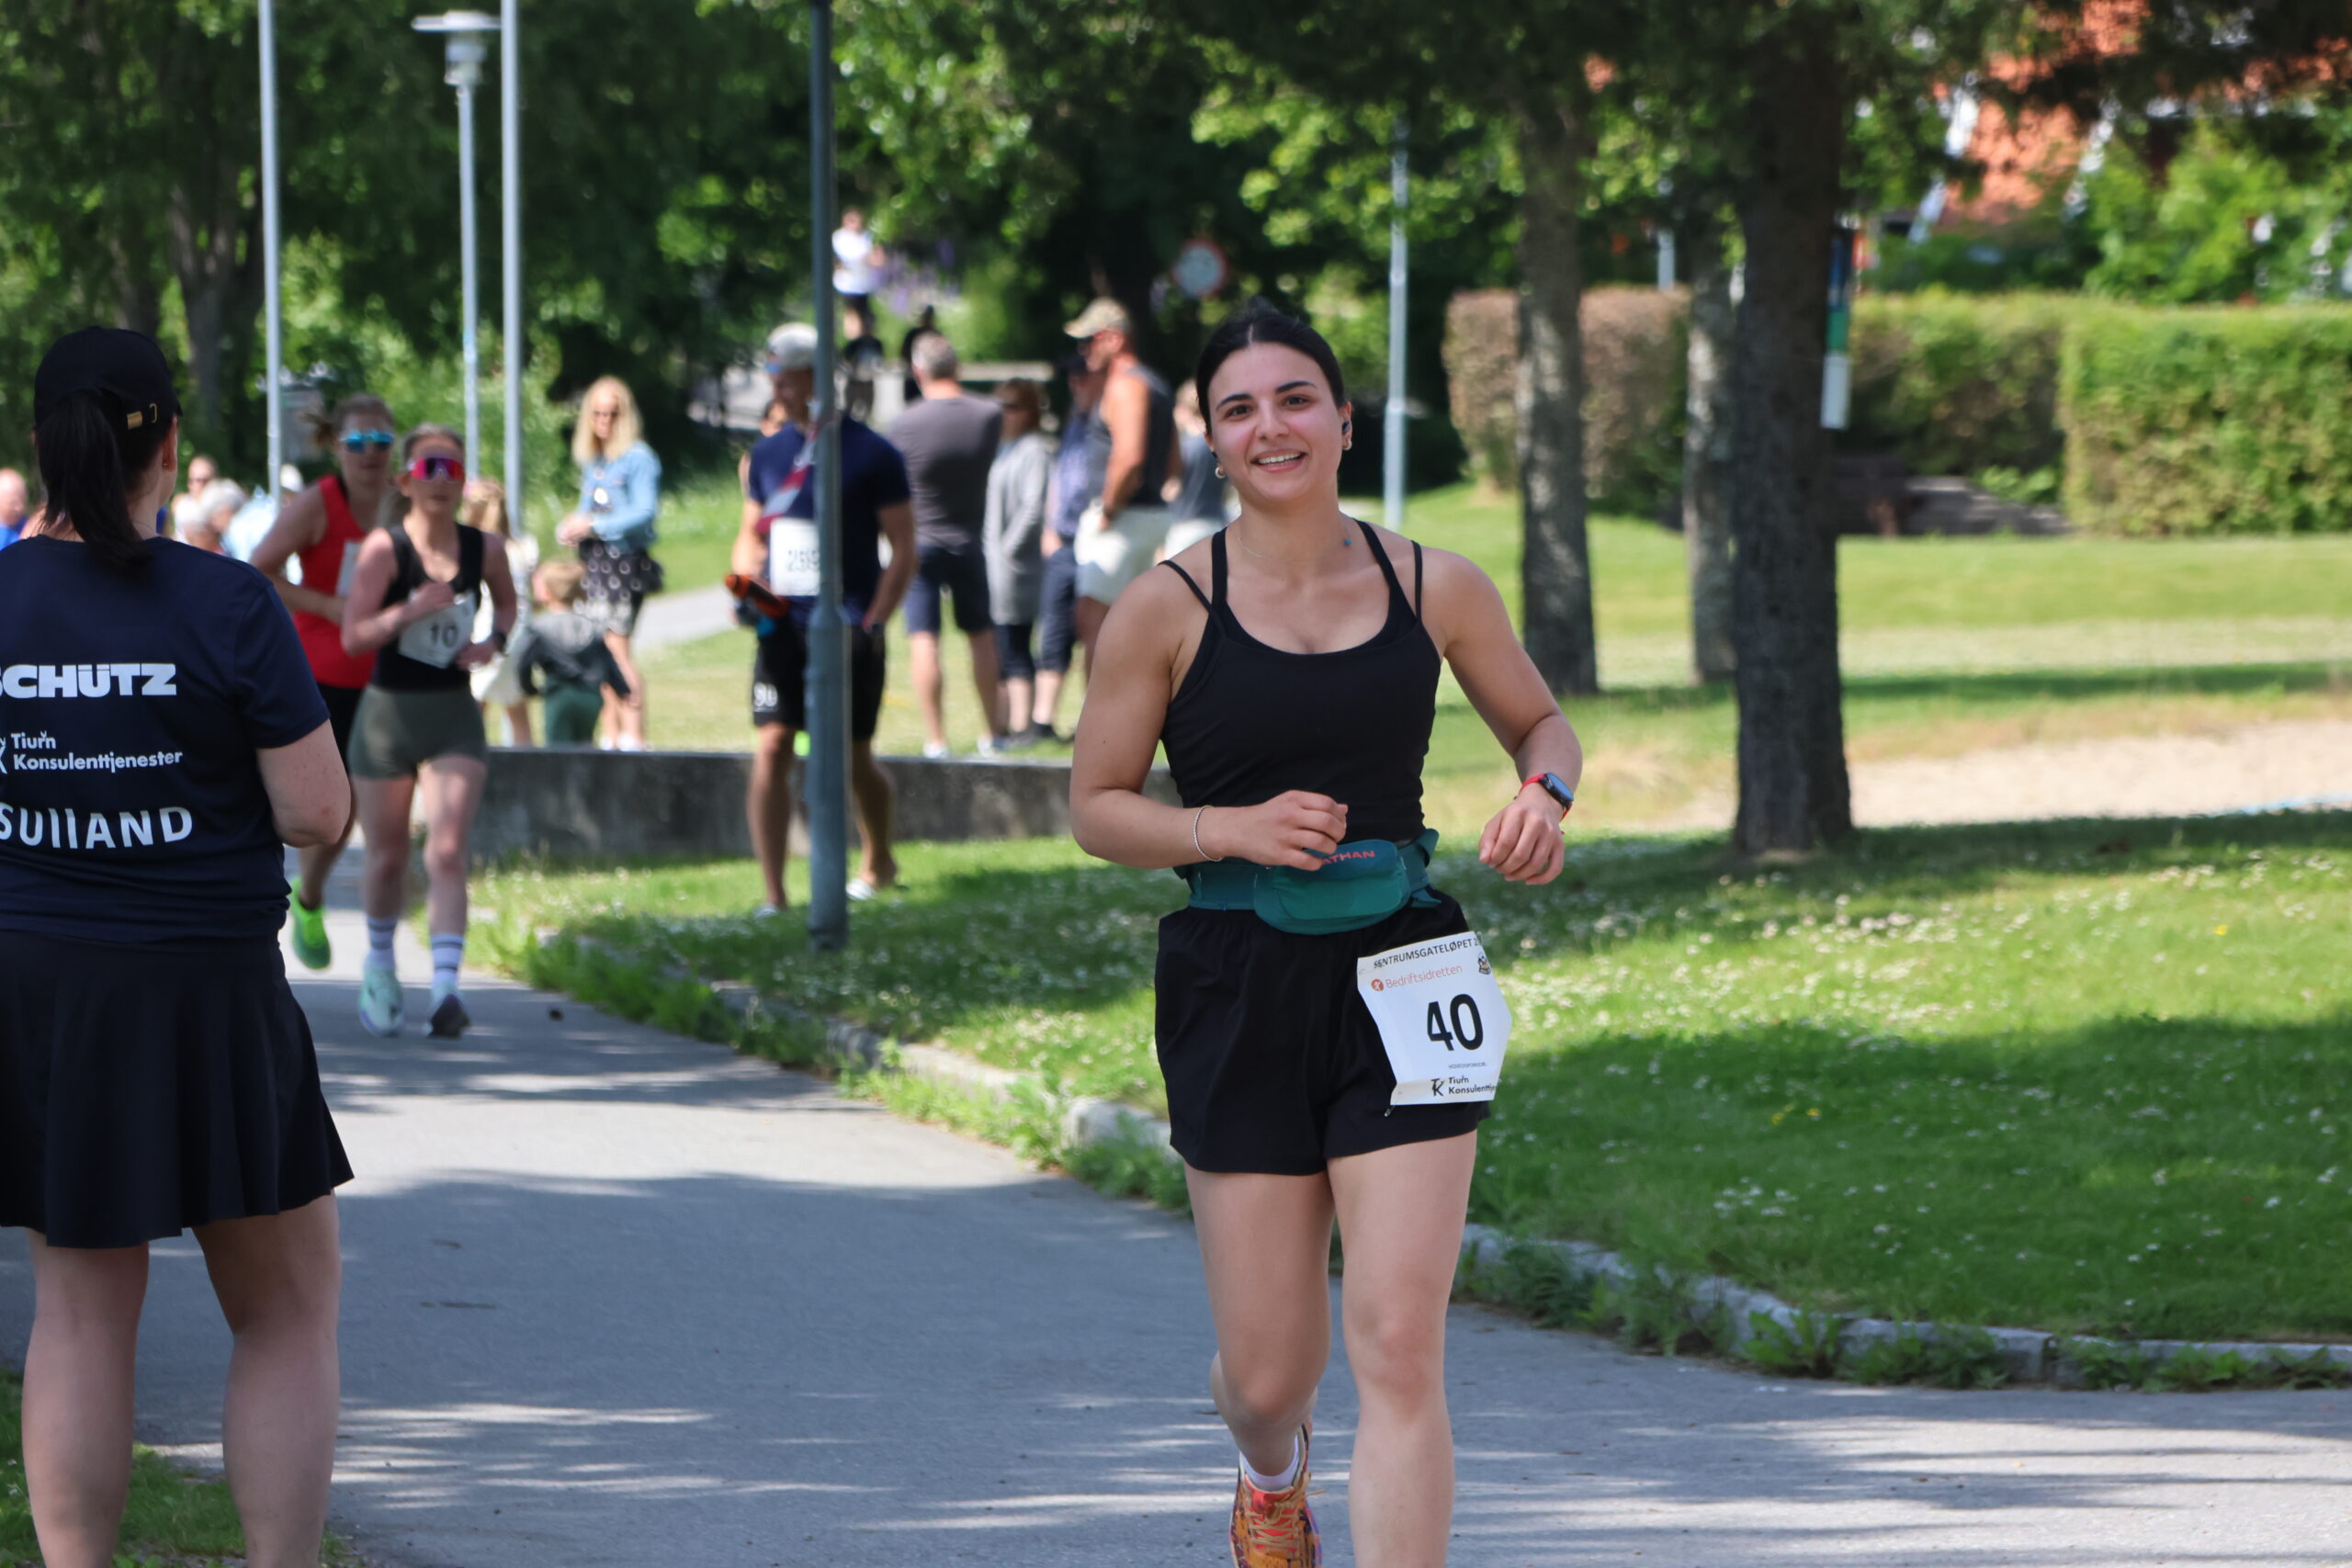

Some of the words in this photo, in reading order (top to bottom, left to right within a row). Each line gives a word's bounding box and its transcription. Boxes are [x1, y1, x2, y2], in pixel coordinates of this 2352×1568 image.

[430, 621, 458, 649] 10
[0, 663, 177, 699] CHÜTZ
[13, 751, 183, 773] Konsulenttjenester
[1322, 852, 1375, 865] ATHAN
[1385, 965, 1463, 989] Bedriftsidretten
[1427, 994, 1483, 1051] 40
